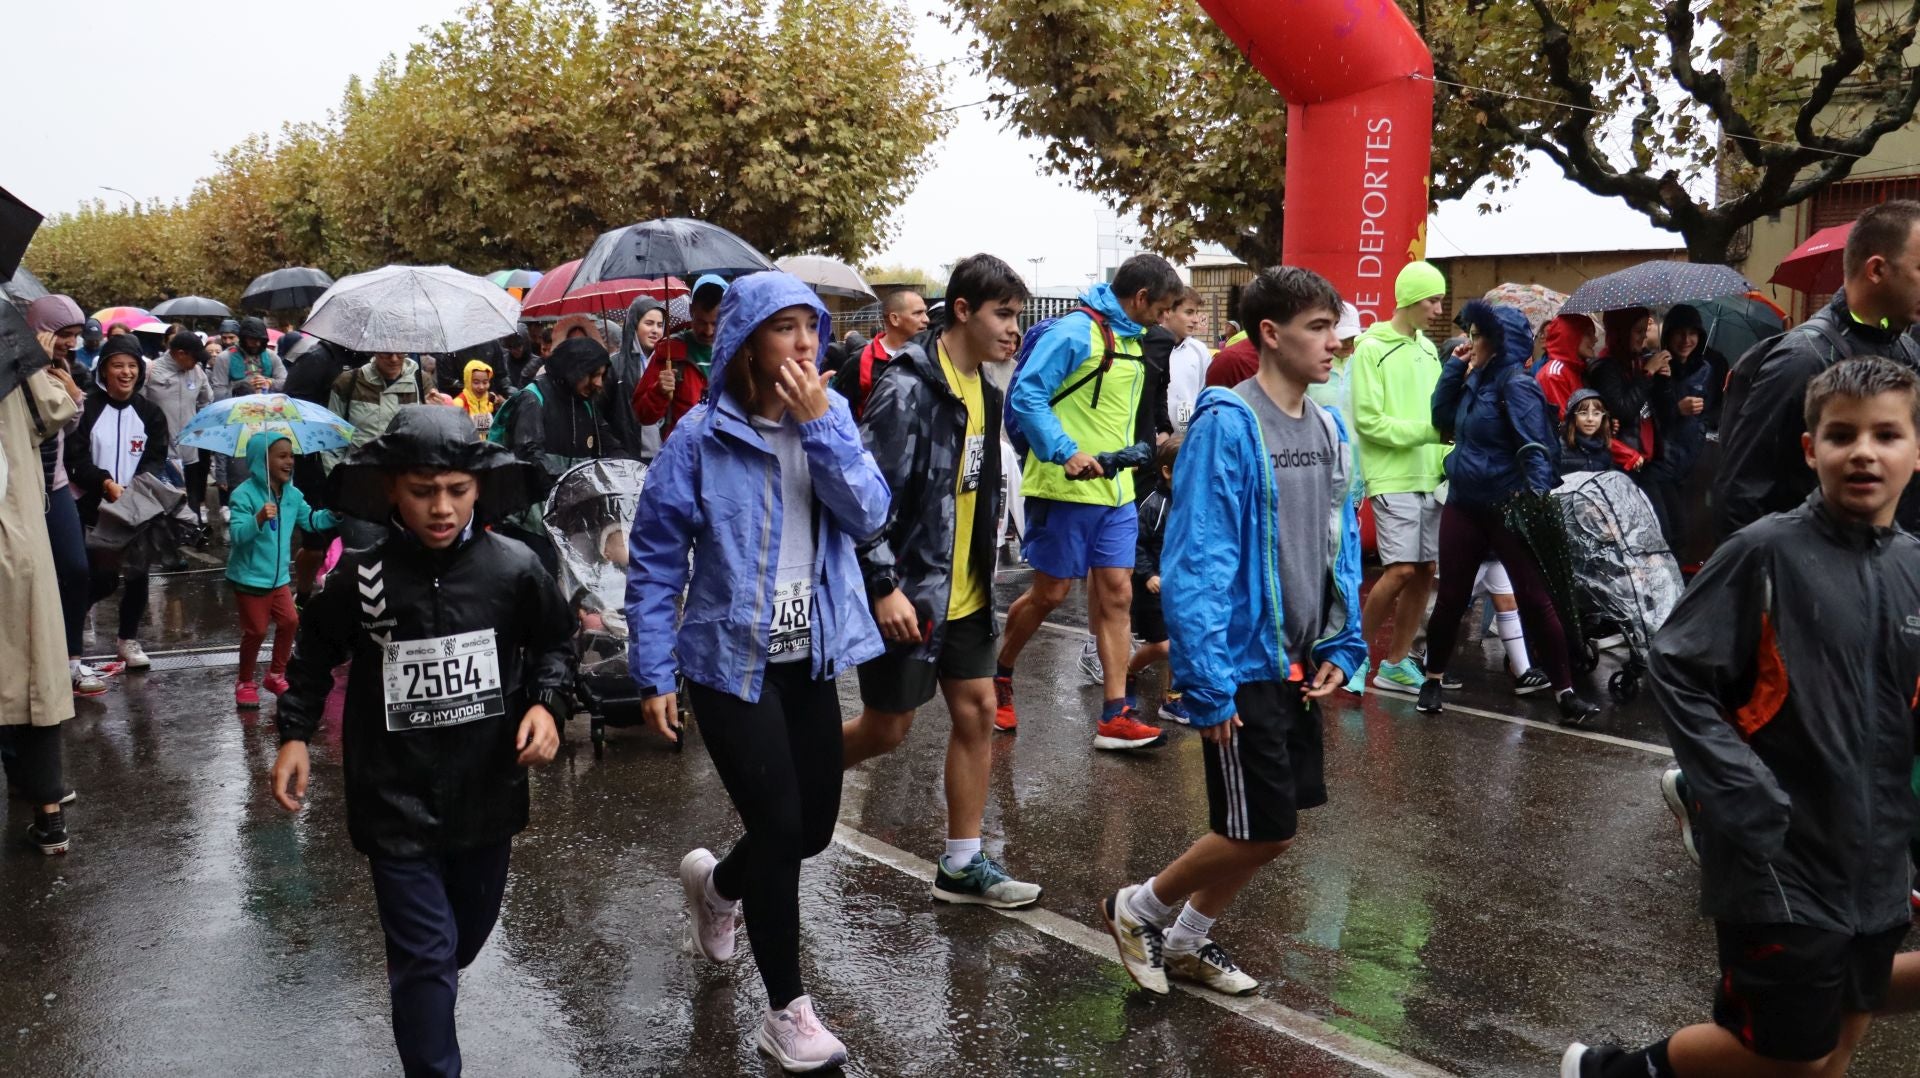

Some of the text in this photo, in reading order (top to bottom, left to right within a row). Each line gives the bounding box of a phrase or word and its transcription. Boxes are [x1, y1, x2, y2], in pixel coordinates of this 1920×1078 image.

[1357, 117, 1392, 278] DEPORTES
[130, 440, 144, 452] M
[970, 449, 984, 473] 25
[1270, 448, 1317, 468] adidas
[361, 617, 398, 630] hummel
[402, 655, 482, 700] 2564
[432, 702, 485, 721] HYUNDAI
